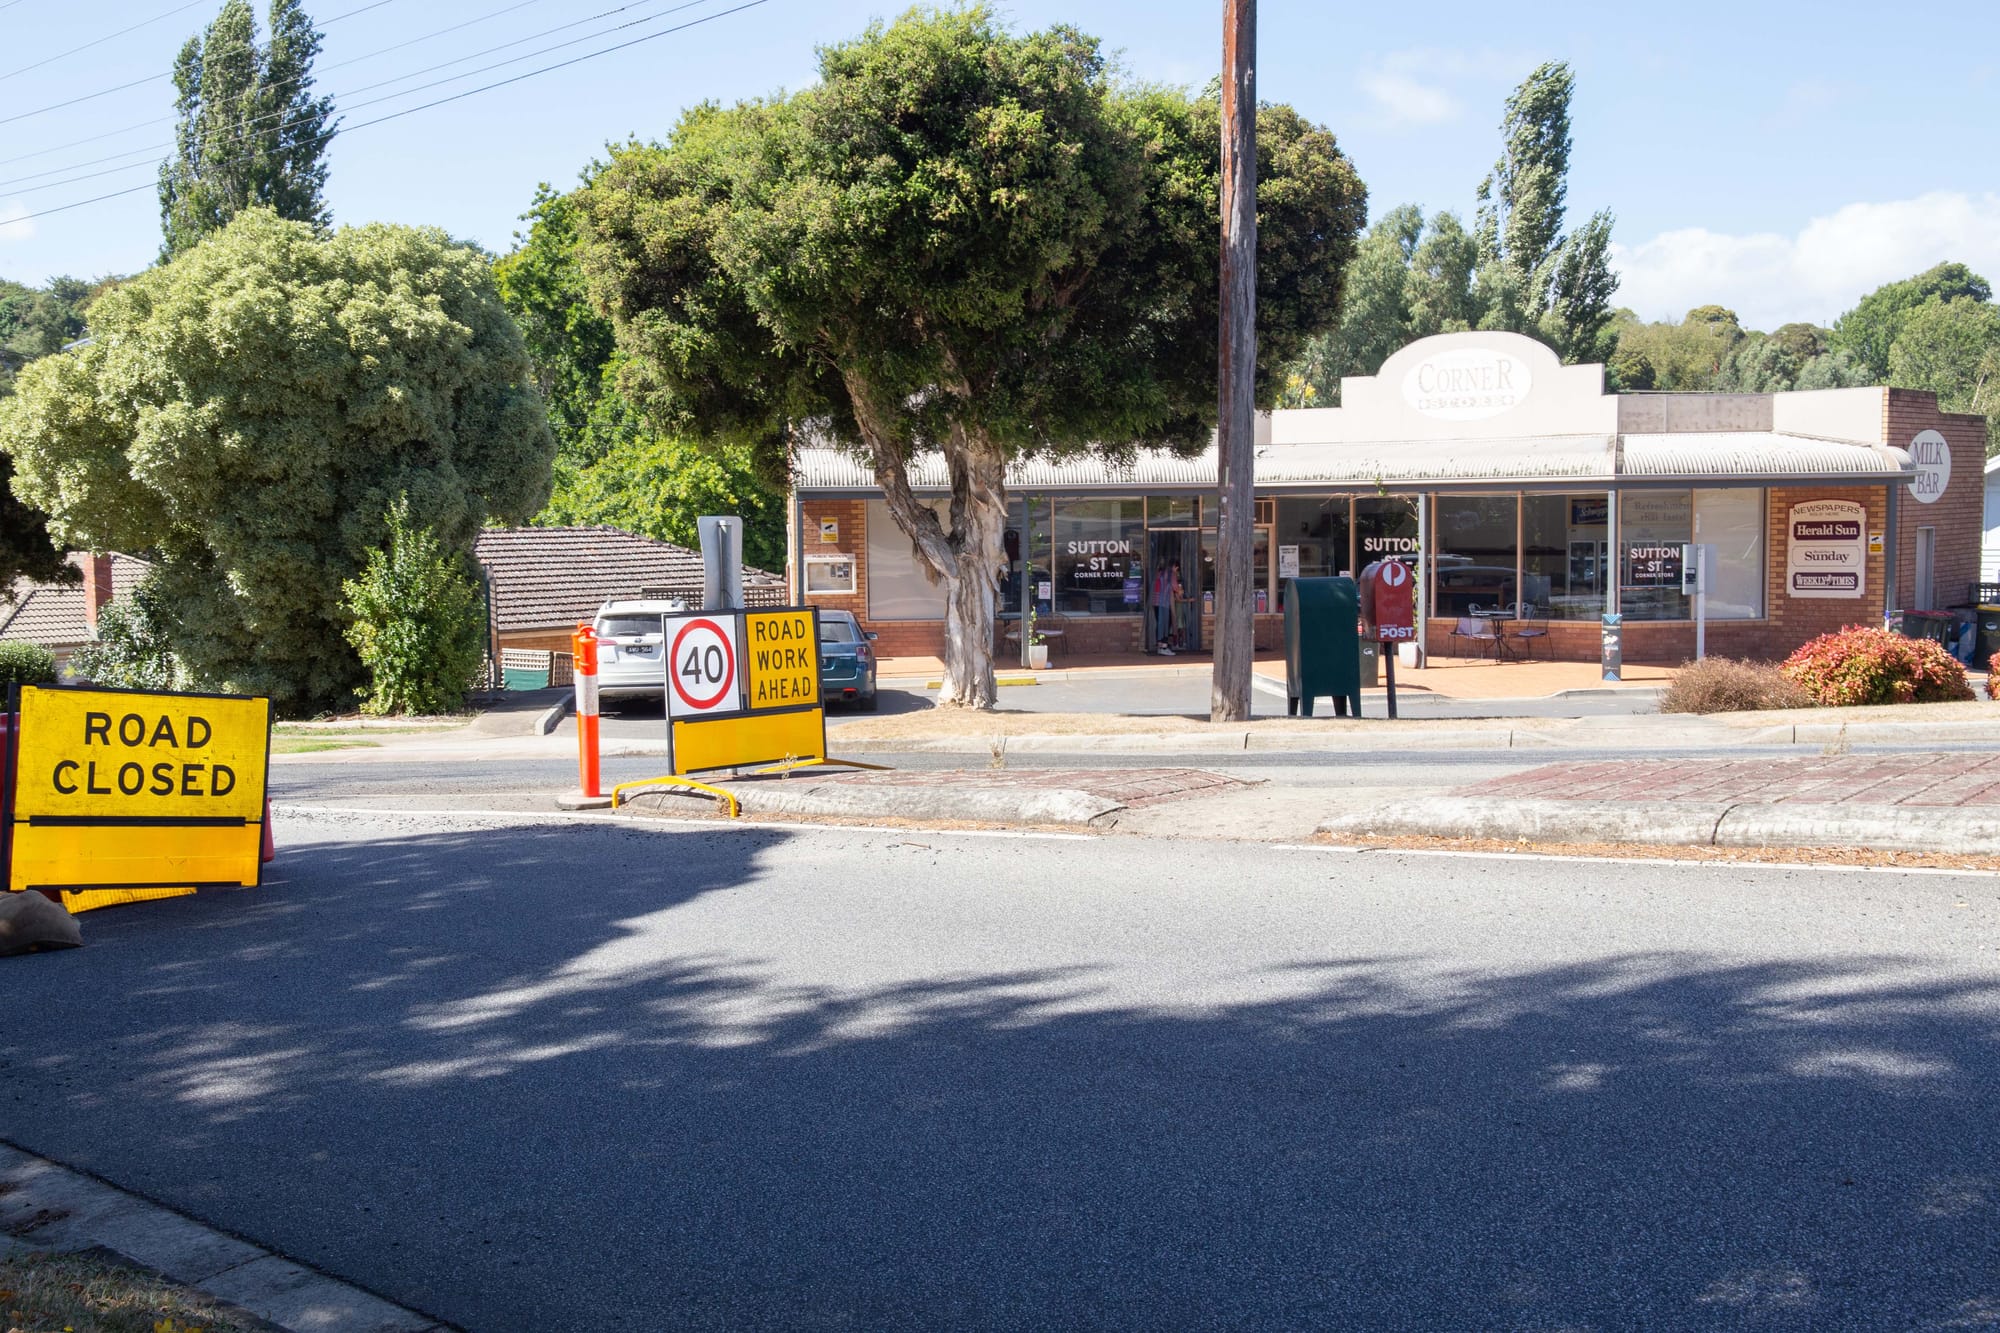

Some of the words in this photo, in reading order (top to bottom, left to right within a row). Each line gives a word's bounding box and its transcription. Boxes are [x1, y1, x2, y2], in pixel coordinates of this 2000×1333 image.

[1418, 359, 1514, 394] CORNER
[1913, 441, 1943, 465] MILK
[1916, 472, 1940, 494] BAR
[1793, 504, 1860, 515] NEWSPAPERS
[1797, 524, 1833, 536] Herald
[1835, 524, 1857, 535] Sun
[1068, 541, 1130, 554] SUTTON
[1631, 547, 1679, 559] SUTTON
[1804, 551, 1849, 563] Sunday
[1090, 557, 1107, 570] ST
[1647, 561, 1662, 572] ST
[755, 619, 805, 641] ROAD
[1380, 627, 1414, 638] POST
[682, 644, 723, 684] 40
[757, 648, 808, 671] WORK
[758, 677, 811, 700] AHEAD
[84, 711, 212, 749] ROAD
[53, 759, 236, 797] CLOSED
